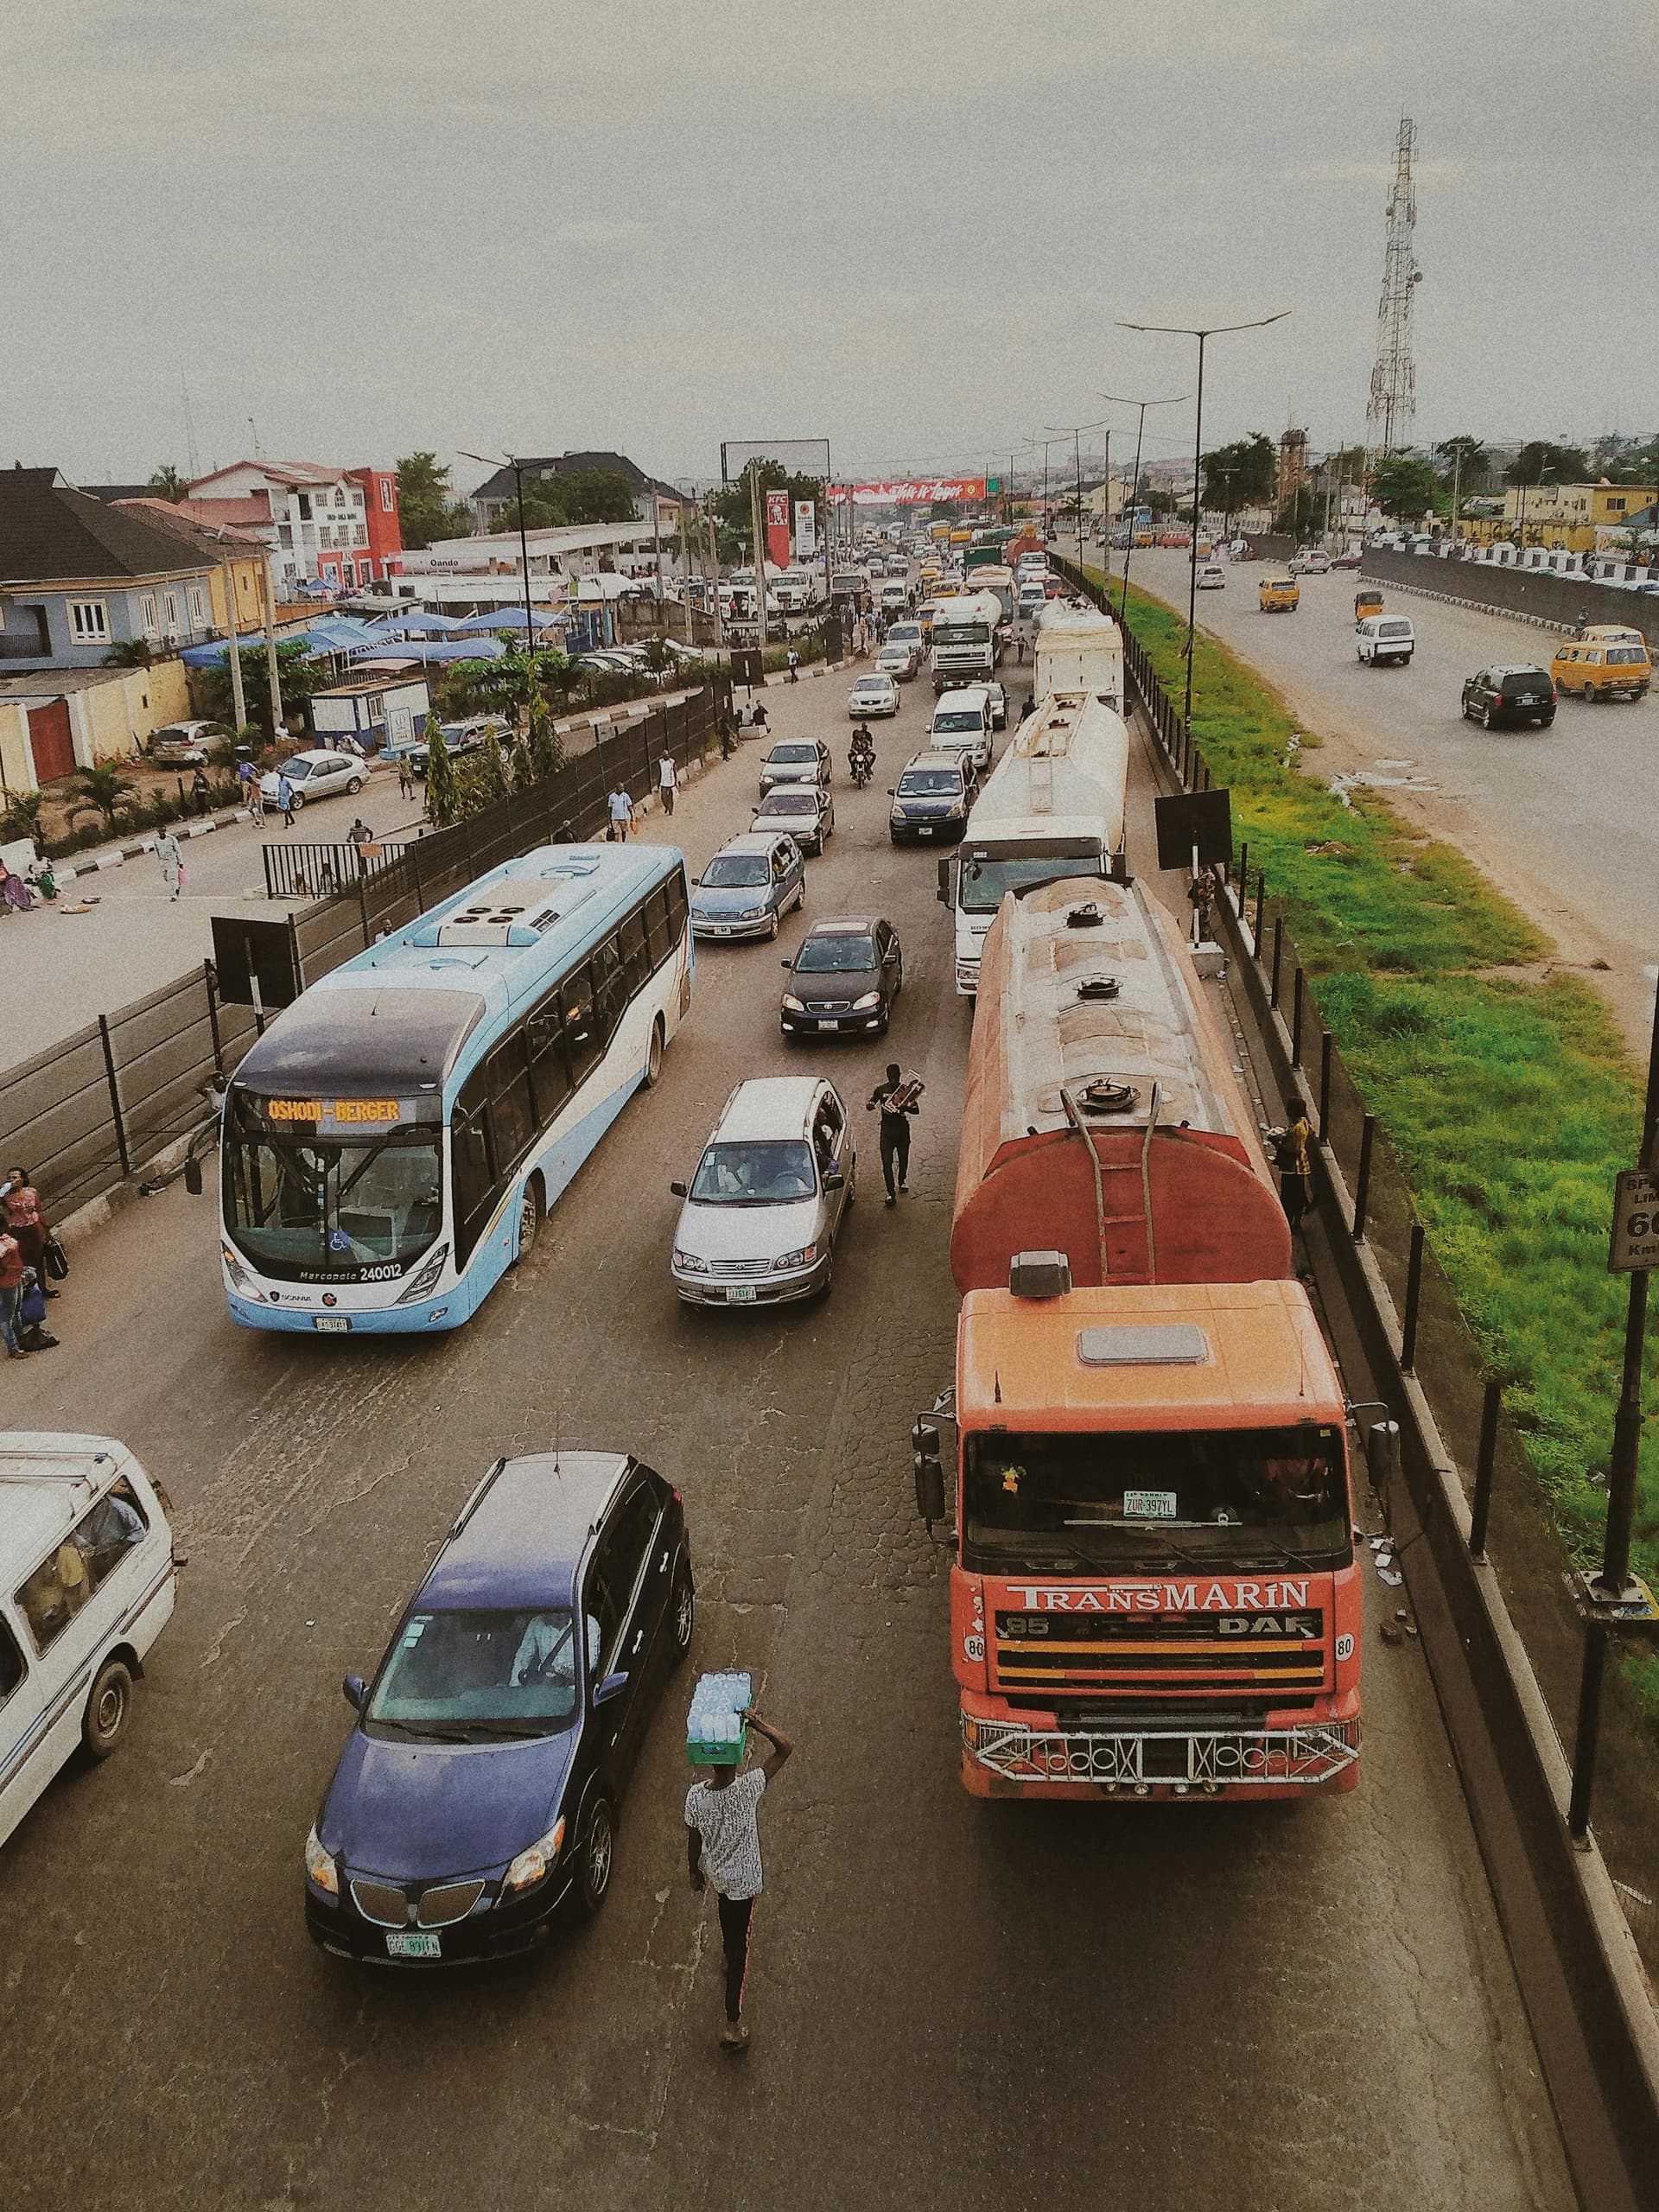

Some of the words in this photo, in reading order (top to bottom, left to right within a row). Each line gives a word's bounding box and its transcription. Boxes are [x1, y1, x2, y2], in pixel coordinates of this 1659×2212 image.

[300, 1271, 357, 1281] Marcopolo
[359, 1263, 403, 1281] 240012
[1006, 1618, 1050, 1635] 95
[1337, 1638, 1352, 1656] 80
